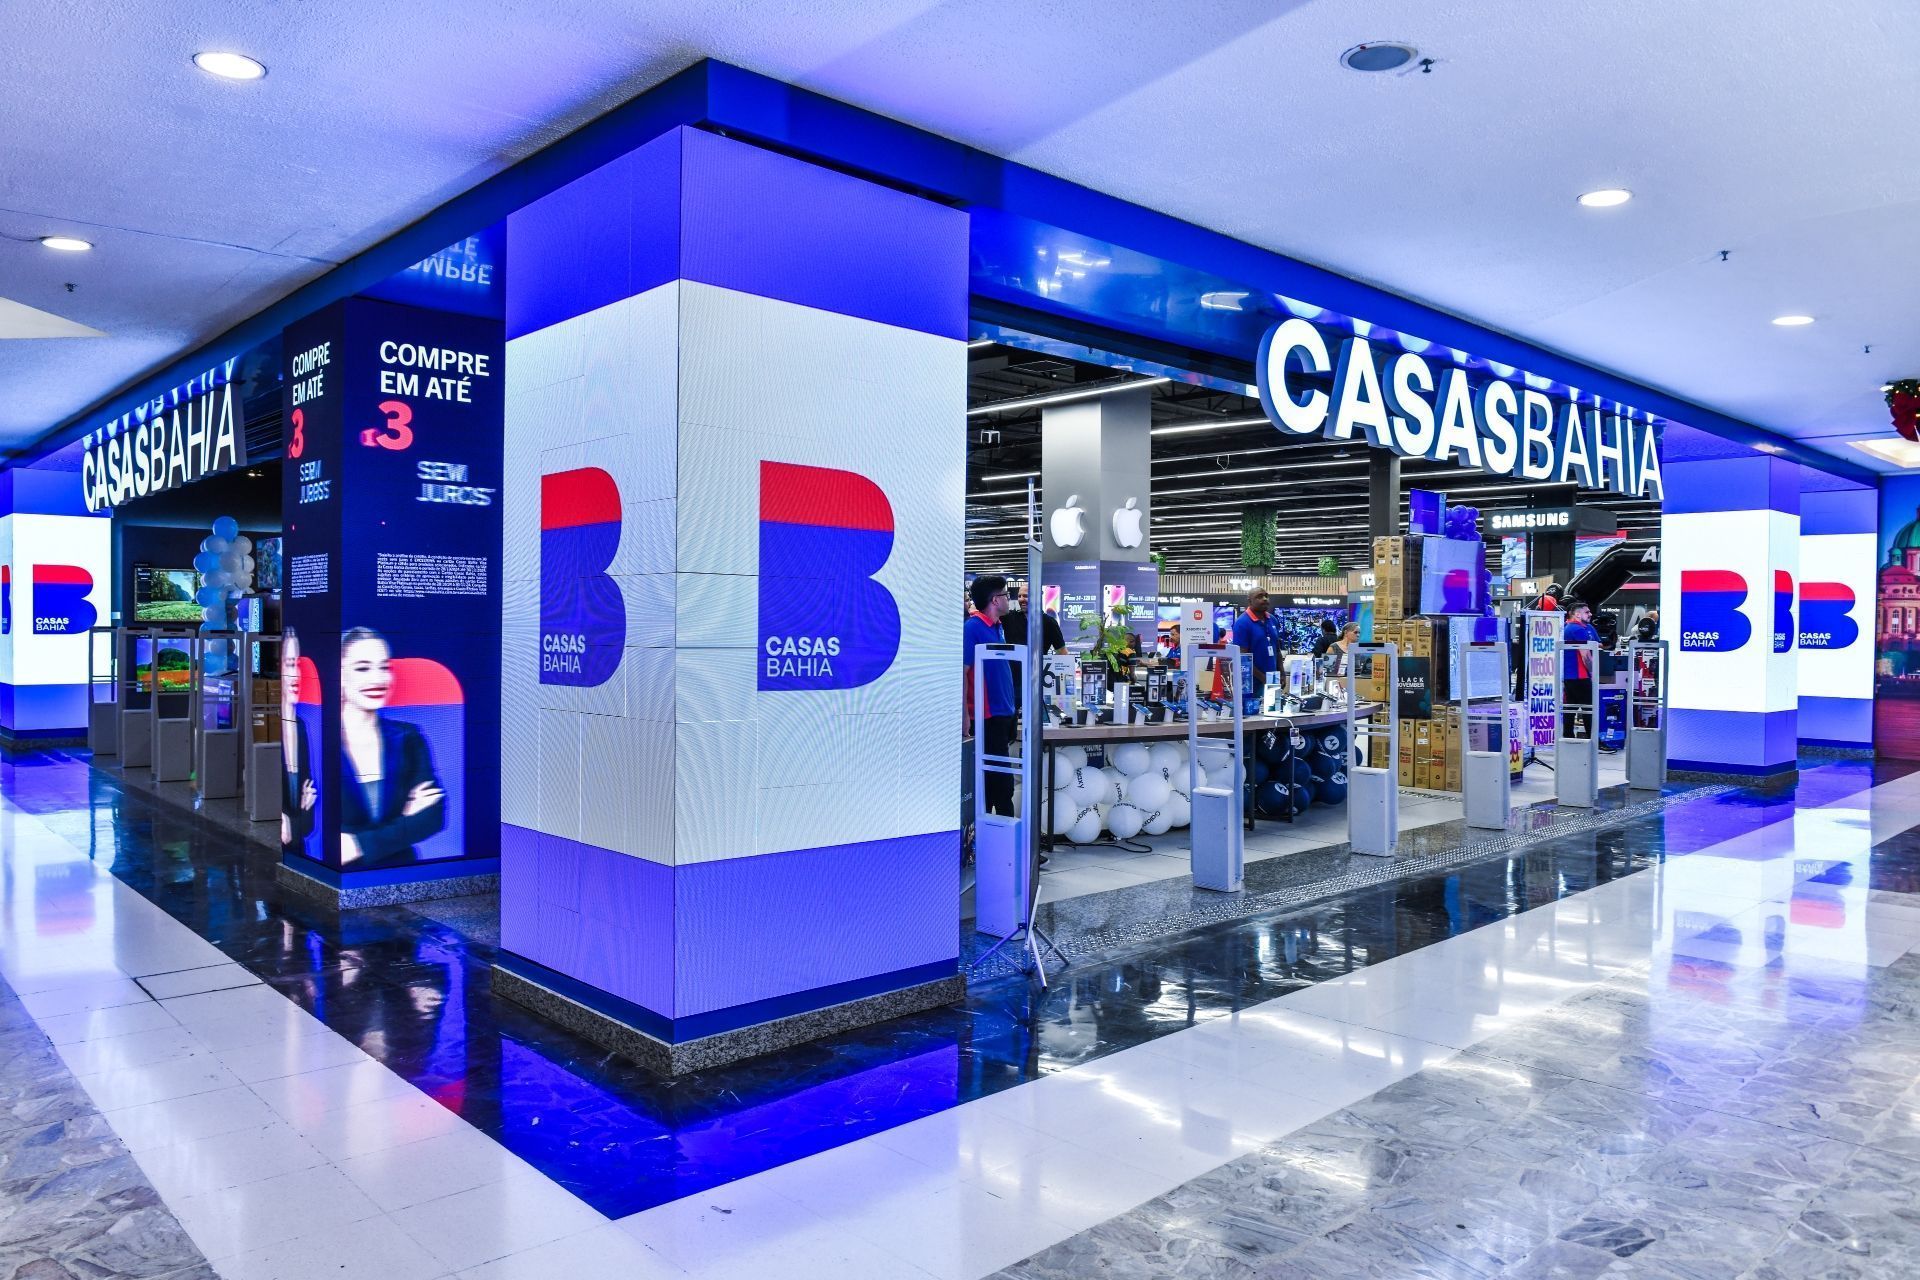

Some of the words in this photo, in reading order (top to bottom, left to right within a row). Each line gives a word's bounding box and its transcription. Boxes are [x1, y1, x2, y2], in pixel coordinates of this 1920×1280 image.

[292, 341, 331, 378] COMPRE
[379, 340, 490, 377] COMPRE
[292, 383, 307, 406] EM
[306, 369, 324, 401] ATÉ
[380, 370, 419, 397] EM
[424, 376, 472, 404] ATÉ
[1266, 318, 1665, 500] CASASBAHIA
[291, 408, 304, 459] 3
[375, 400, 414, 451] 3
[82, 382, 237, 514] CASASBAHIA
[1491, 511, 1569, 529] SAMSUNG
[35, 617, 70, 625] CASAS
[1535, 617, 1553, 636] NÃO
[543, 634, 586, 654] CASAS
[1532, 637, 1555, 653] FECHE
[1683, 631, 1720, 640] CASAS
[1683, 639, 1716, 648] BAHIA
[1799, 638, 1828, 646] BAHIA
[1800, 632, 1832, 640] CASAS
[765, 636, 841, 657] CASAS
[543, 654, 582, 674] BAHIA
[765, 657, 833, 677] BAHIA
[1531, 682, 1553, 697] SEM
[1530, 698, 1555, 714] ANTES
